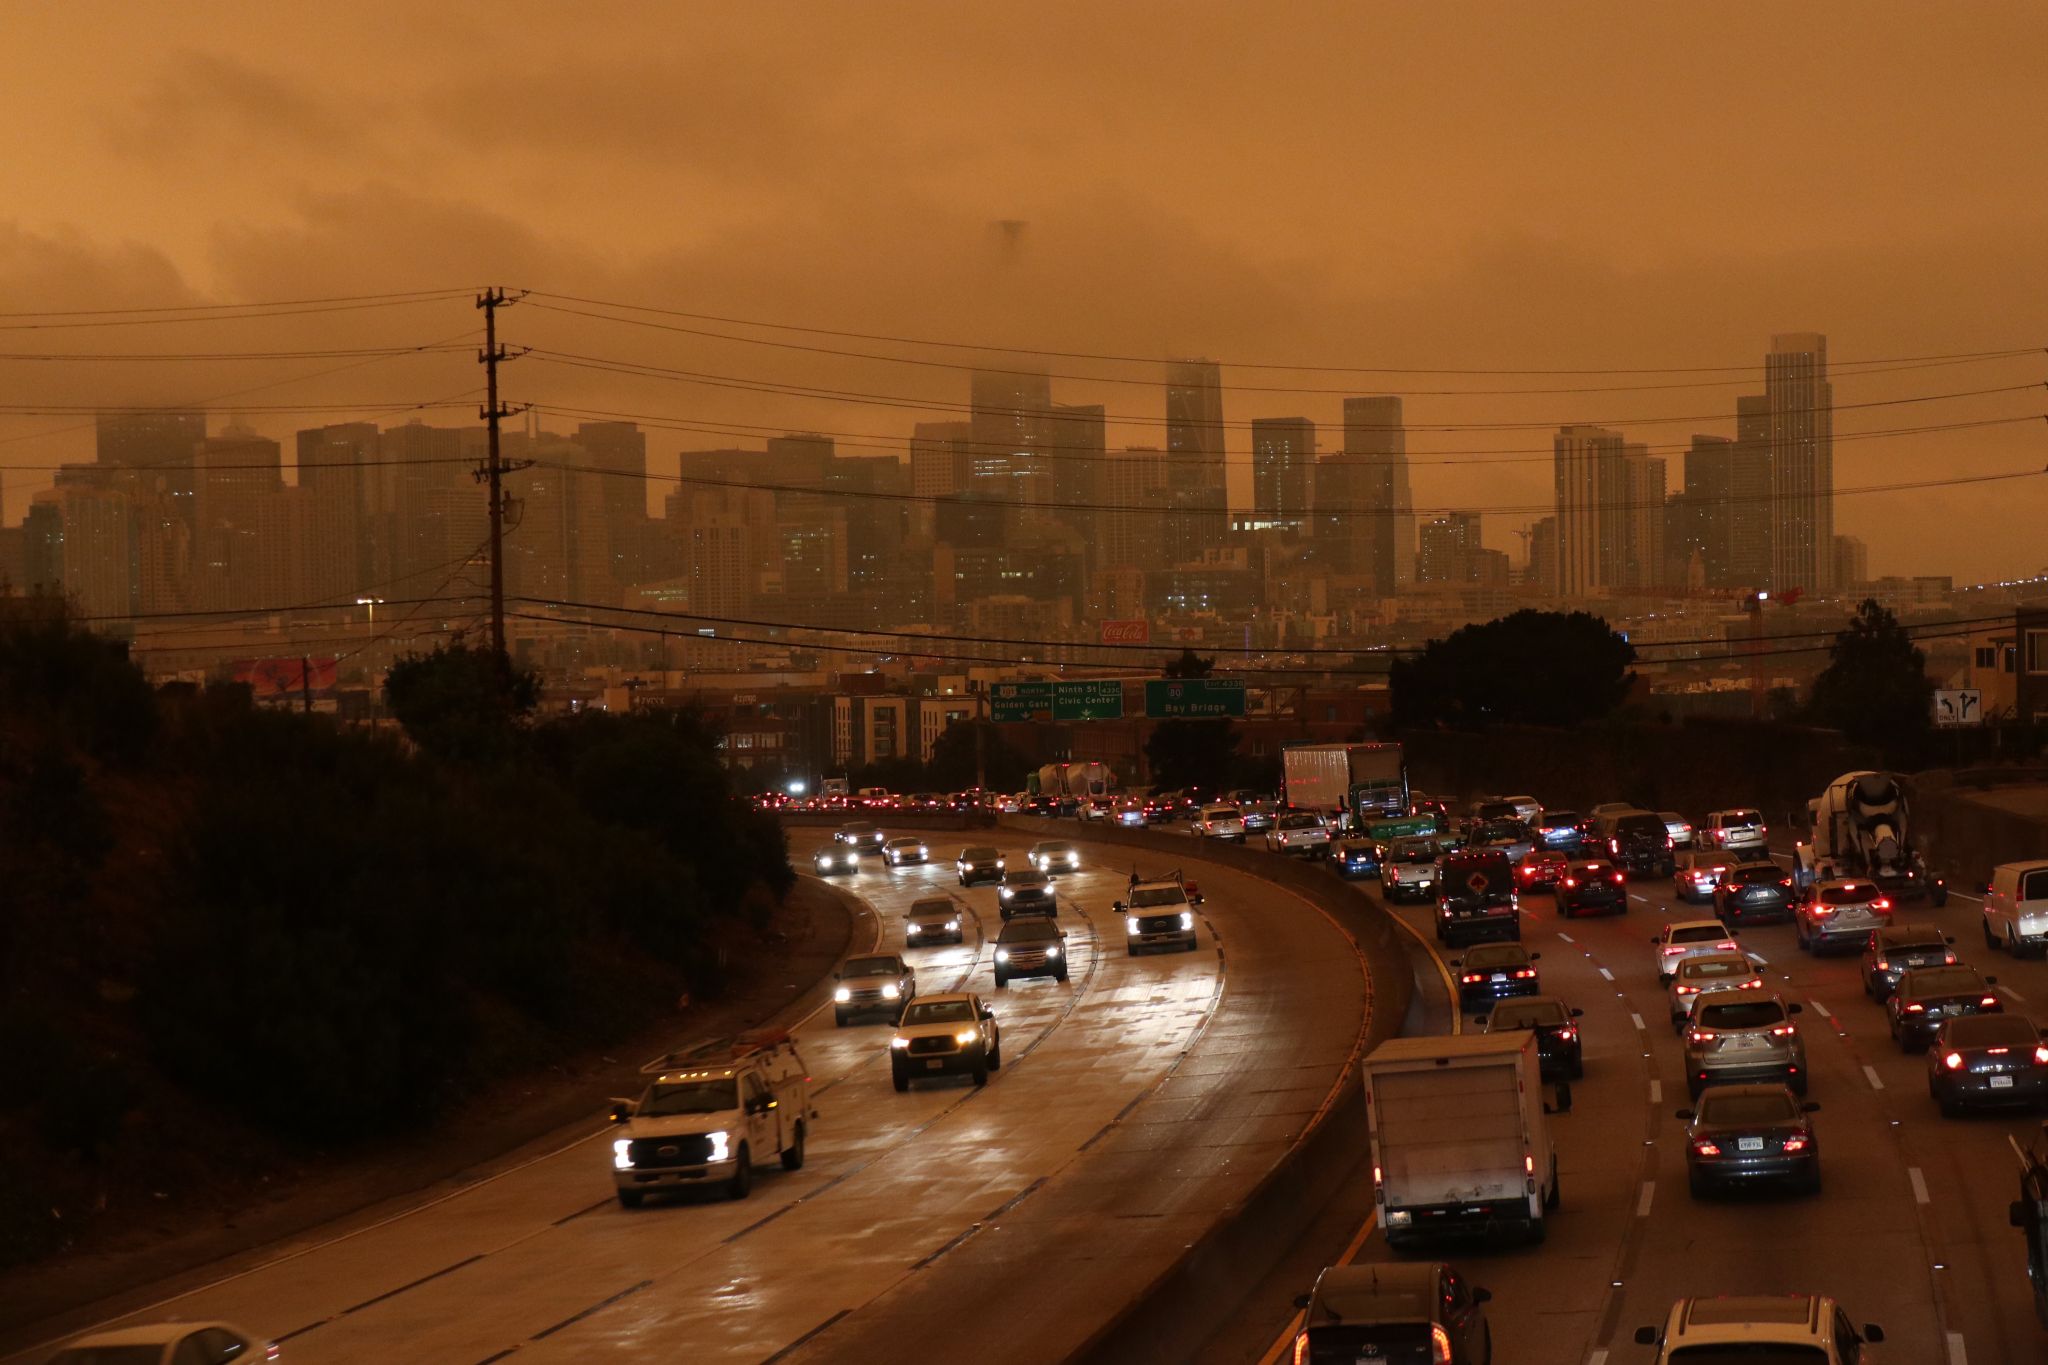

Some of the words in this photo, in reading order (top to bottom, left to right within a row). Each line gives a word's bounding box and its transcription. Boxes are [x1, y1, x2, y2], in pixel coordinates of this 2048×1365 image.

[1058, 685, 1083, 694] Ninth
[1087, 685, 1097, 693] St
[994, 701, 1025, 709] Golden
[1028, 700, 1049, 708] Gate
[1058, 697, 1081, 705] Civic
[1085, 696, 1115, 704] Center
[1165, 703, 1186, 713] Bay
[1190, 703, 1227, 713] Bridge
